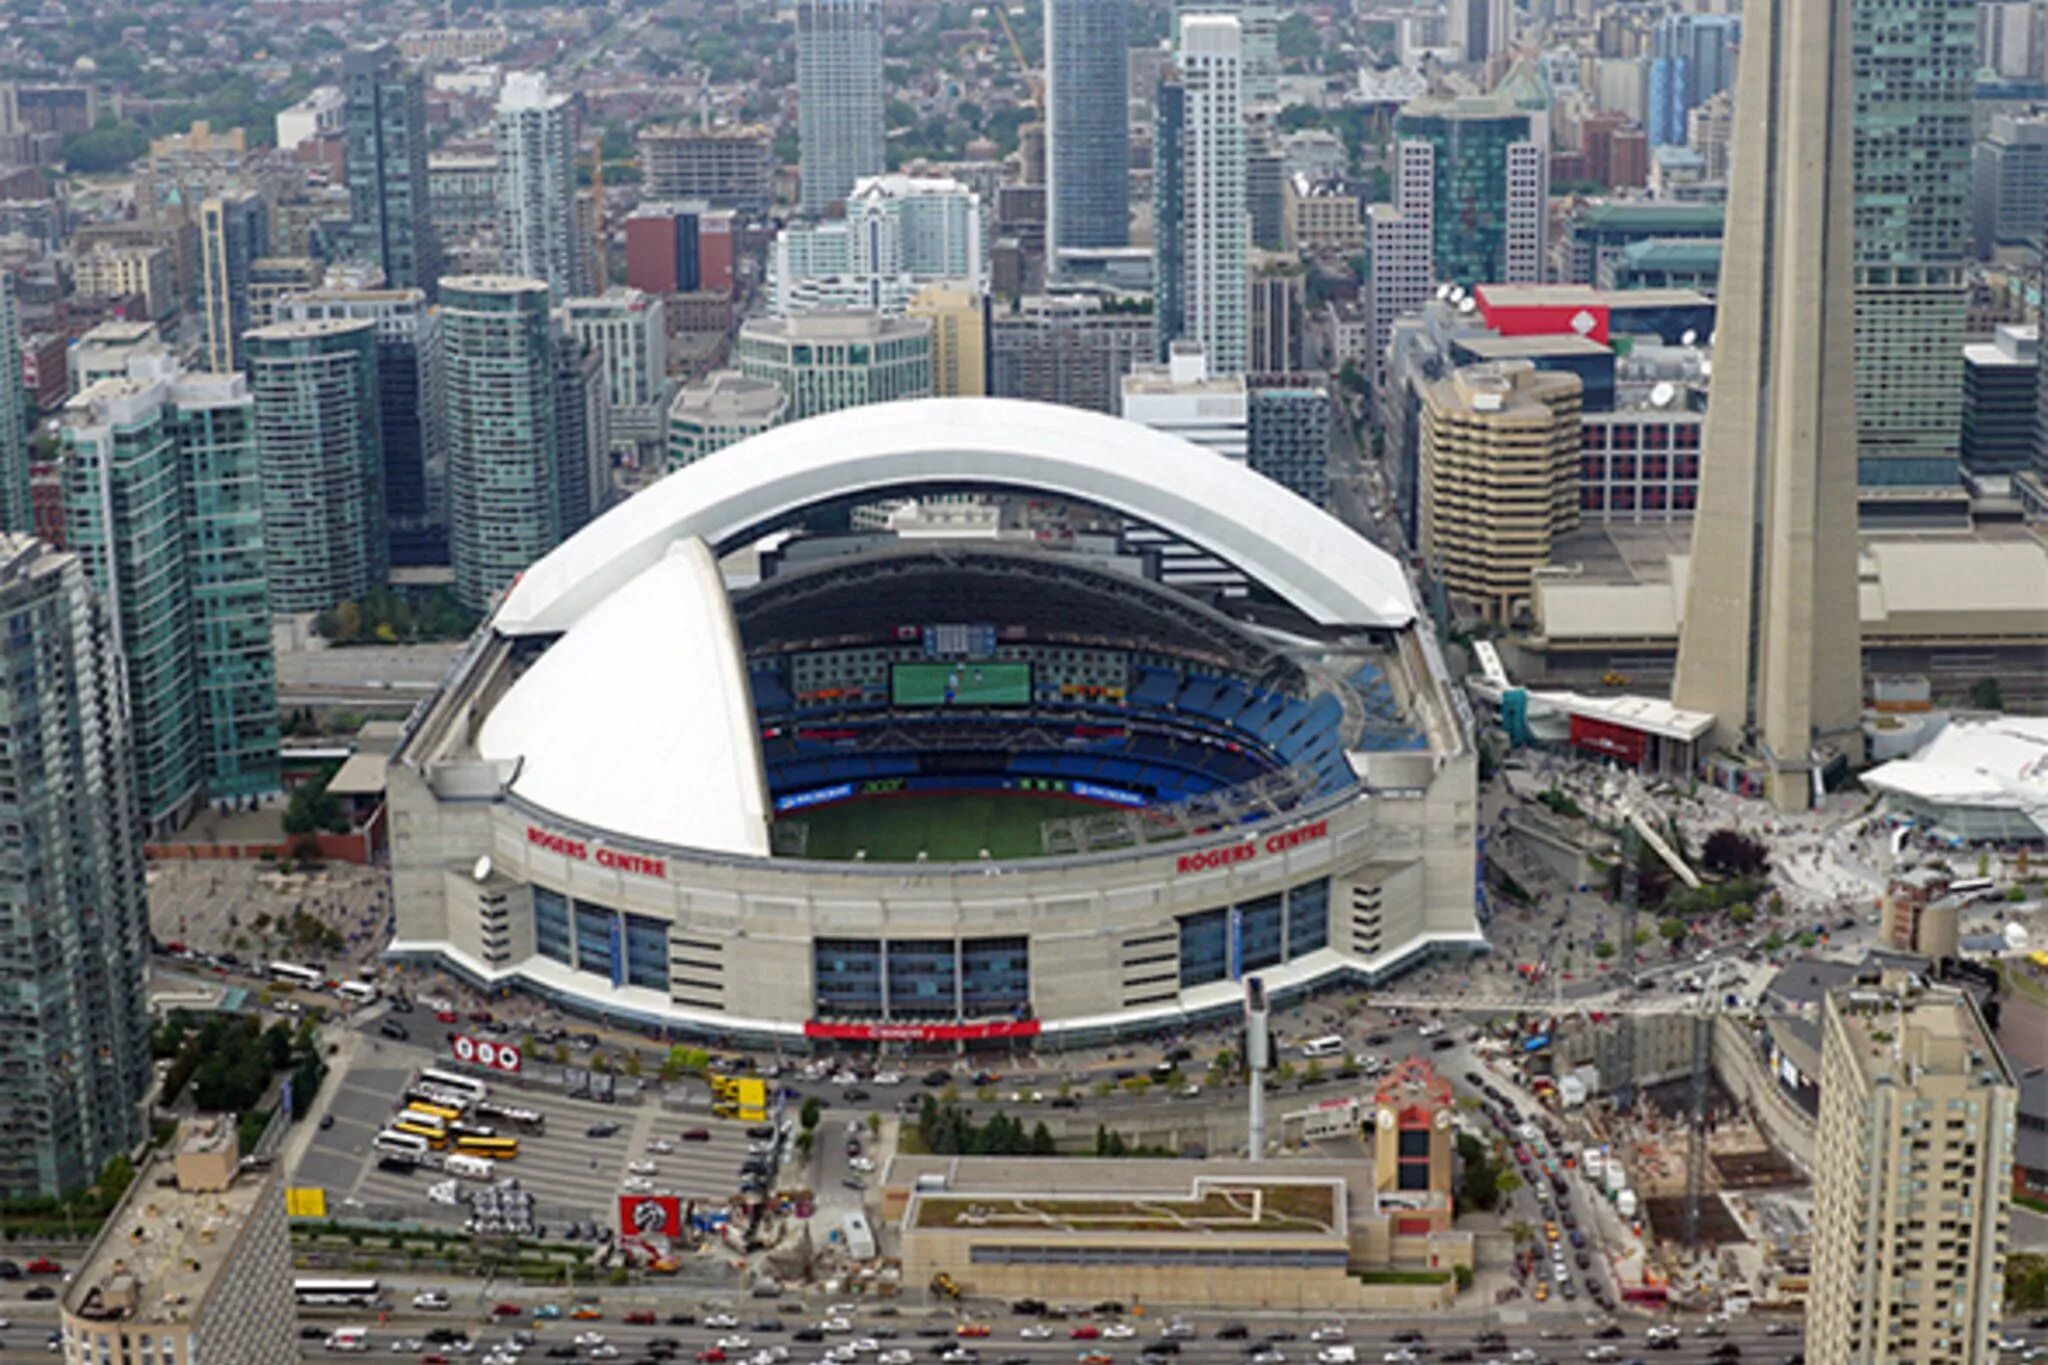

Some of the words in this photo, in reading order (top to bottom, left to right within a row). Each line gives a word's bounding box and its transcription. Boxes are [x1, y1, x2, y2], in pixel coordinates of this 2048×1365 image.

[526, 826, 587, 861] ROGERS
[595, 847, 666, 879] CENTRE
[1176, 841, 1257, 873] ROGERS
[1265, 819, 1329, 854] CENTRE
